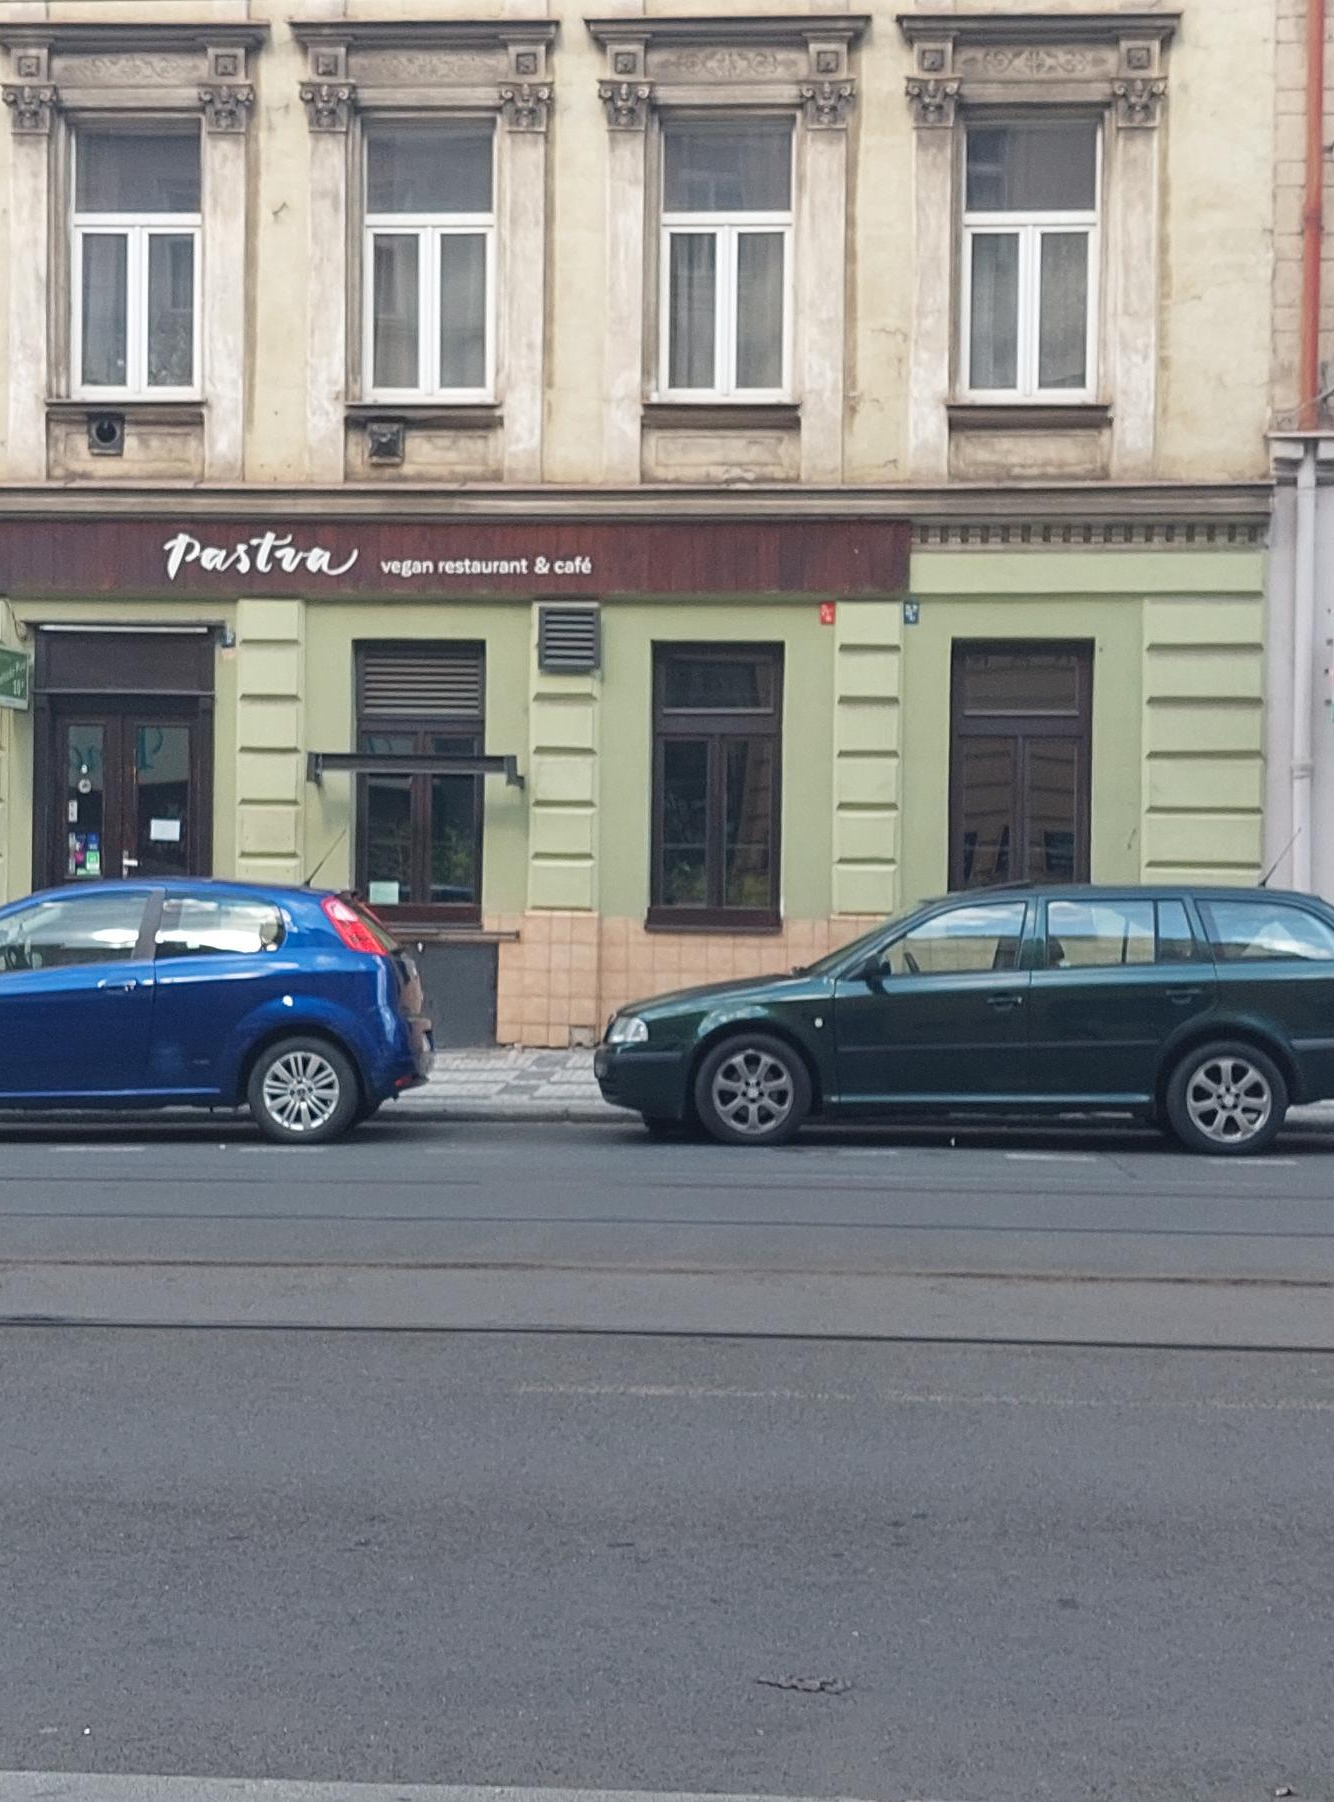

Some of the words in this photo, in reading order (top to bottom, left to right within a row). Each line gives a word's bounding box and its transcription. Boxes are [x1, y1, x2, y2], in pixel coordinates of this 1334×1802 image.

[163, 531, 358, 581] Pastva
[380, 559, 434, 578] vegan
[437, 557, 528, 575] restaurant
[533, 556, 550, 575] &
[553, 555, 592, 575] café
